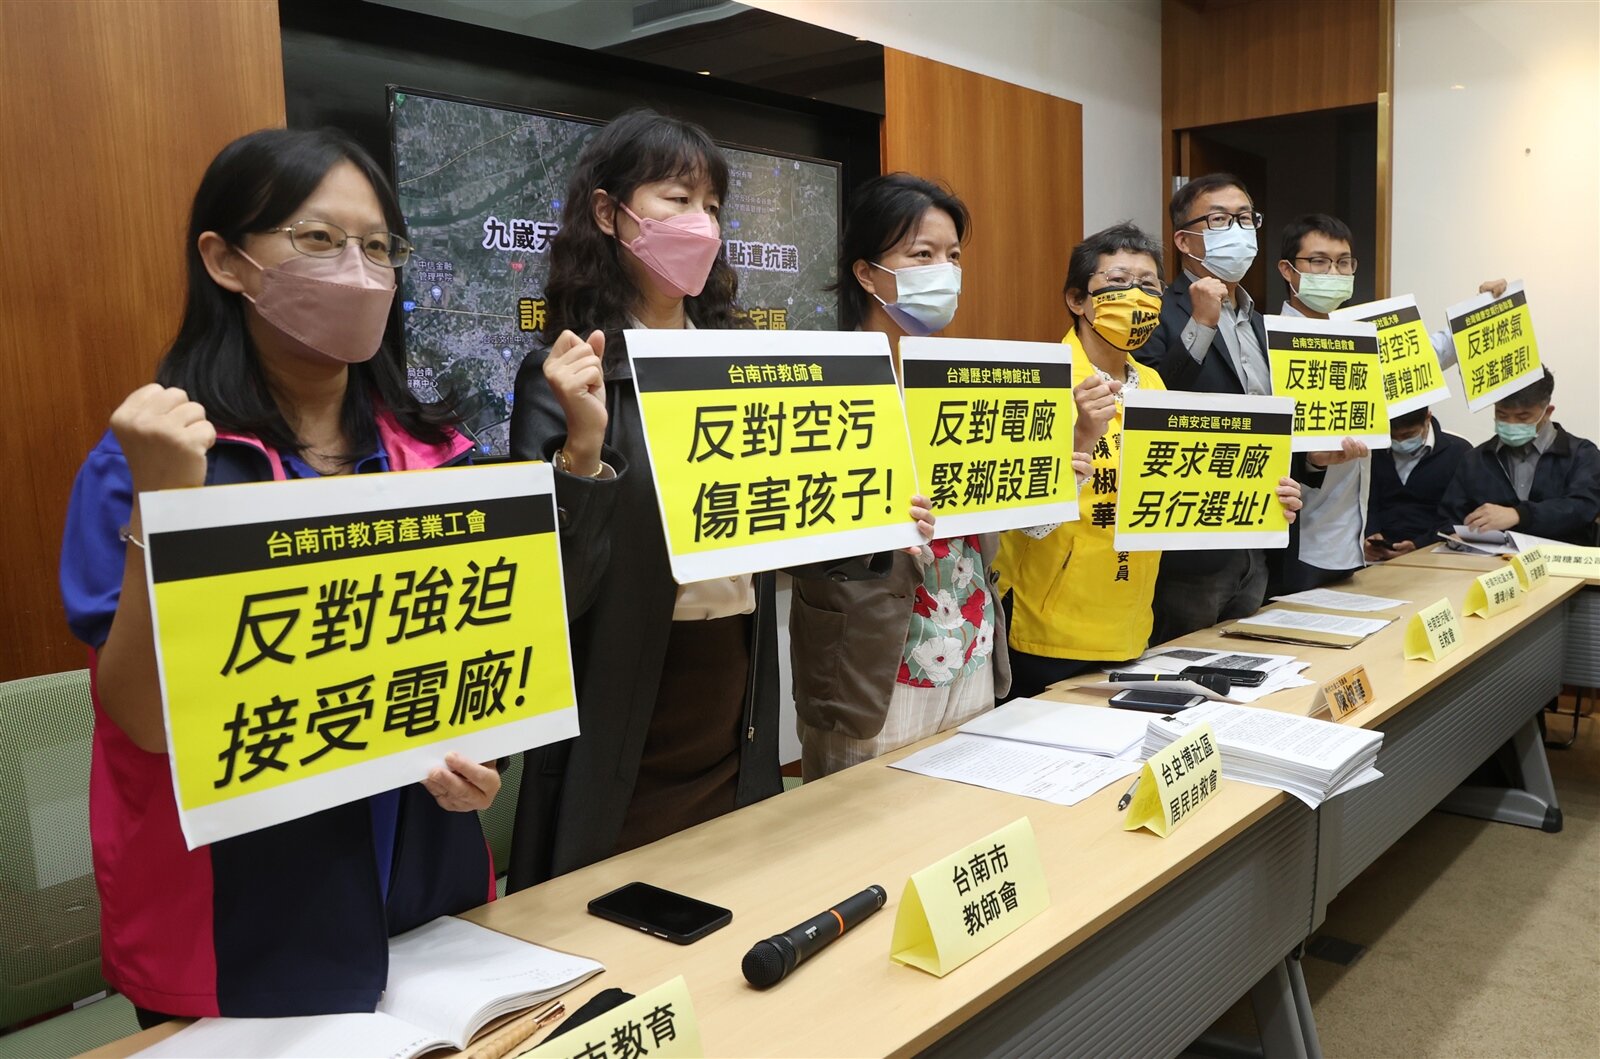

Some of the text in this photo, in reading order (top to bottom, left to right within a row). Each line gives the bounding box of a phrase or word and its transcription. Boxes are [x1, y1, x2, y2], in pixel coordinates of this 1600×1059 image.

[727, 241, 799, 271] 點遭抗議
[519, 300, 547, 331] 訴
[1467, 313, 1522, 360] 反對燃氣
[727, 363, 824, 385] 台南市教師會
[947, 367, 1041, 385] 台灣歷史博物館社區
[1285, 359, 1368, 391] 反對電廠
[1472, 345, 1530, 395] 浮濫擴張!
[686, 399, 876, 464] 反對空污
[930, 399, 1057, 447] 反對電廠
[1167, 413, 1252, 431] 台南安定區中榮里
[930, 456, 1061, 508] 緊鄰設置!
[1092, 436, 1118, 529] 陳椒華
[1139, 440, 1273, 479] 要求電廠
[692, 468, 893, 543] 傷害孩子!
[1128, 489, 1272, 528] 另行選址!
[266, 509, 487, 559] 台南市教育產業工會
[220, 555, 518, 677] 反對強迫
[213, 645, 533, 789] 接受電廠!
[1160, 732, 1215, 789] 台史博社區
[1169, 768, 1219, 827] 居民自救會
[951, 843, 1010, 897] 台南市
[962, 879, 1019, 938] 教師會
